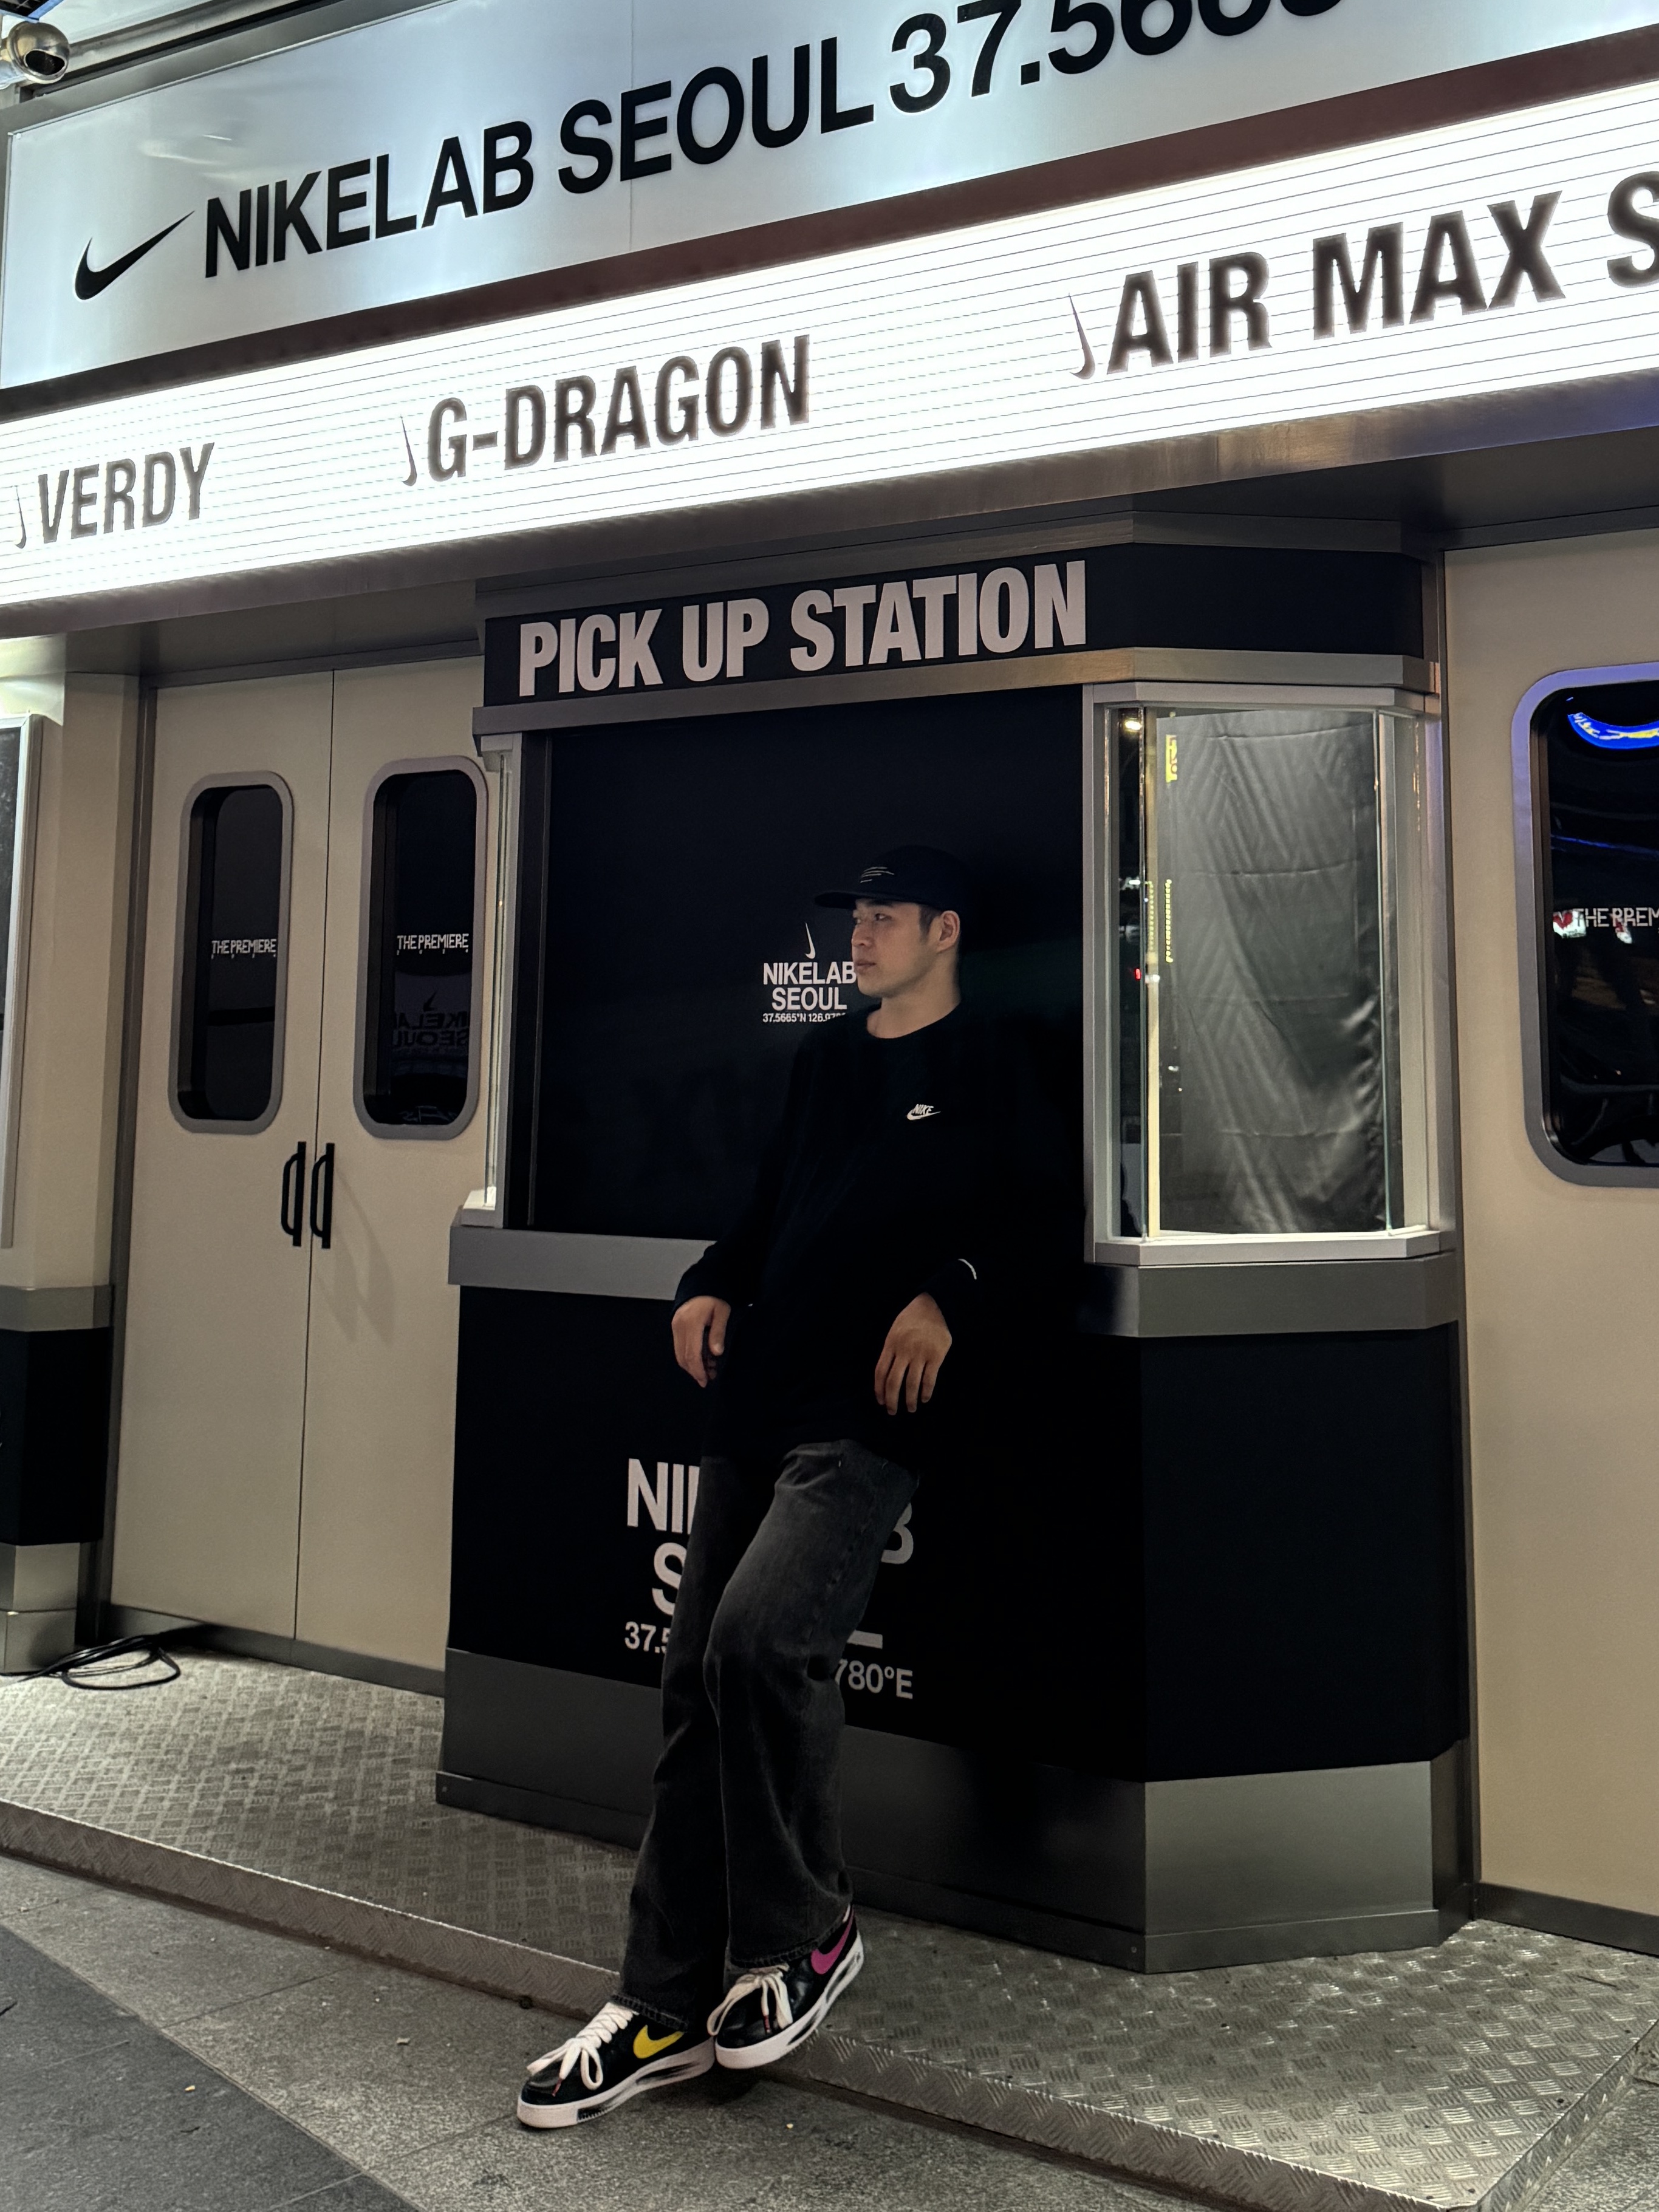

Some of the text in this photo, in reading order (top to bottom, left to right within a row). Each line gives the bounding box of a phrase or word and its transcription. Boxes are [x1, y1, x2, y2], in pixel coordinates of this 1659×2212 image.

[204, 0, 1341, 279] NIKELAB SEOUL 37.56
[1107, 251, 1272, 374] AIR
[1311, 190, 1565, 341] MAX
[427, 333, 810, 482] G-DRAGON
[38, 442, 215, 545] VERDY
[519, 559, 1087, 697] PICK UP STATION
[211, 938, 277, 954] THE PREMIERE
[397, 933, 469, 950] THE PREMIERE
[1573, 907, 1610, 927] THE
[763, 961, 857, 985] NIKELAB
[771, 986, 847, 1011] SEOUL
